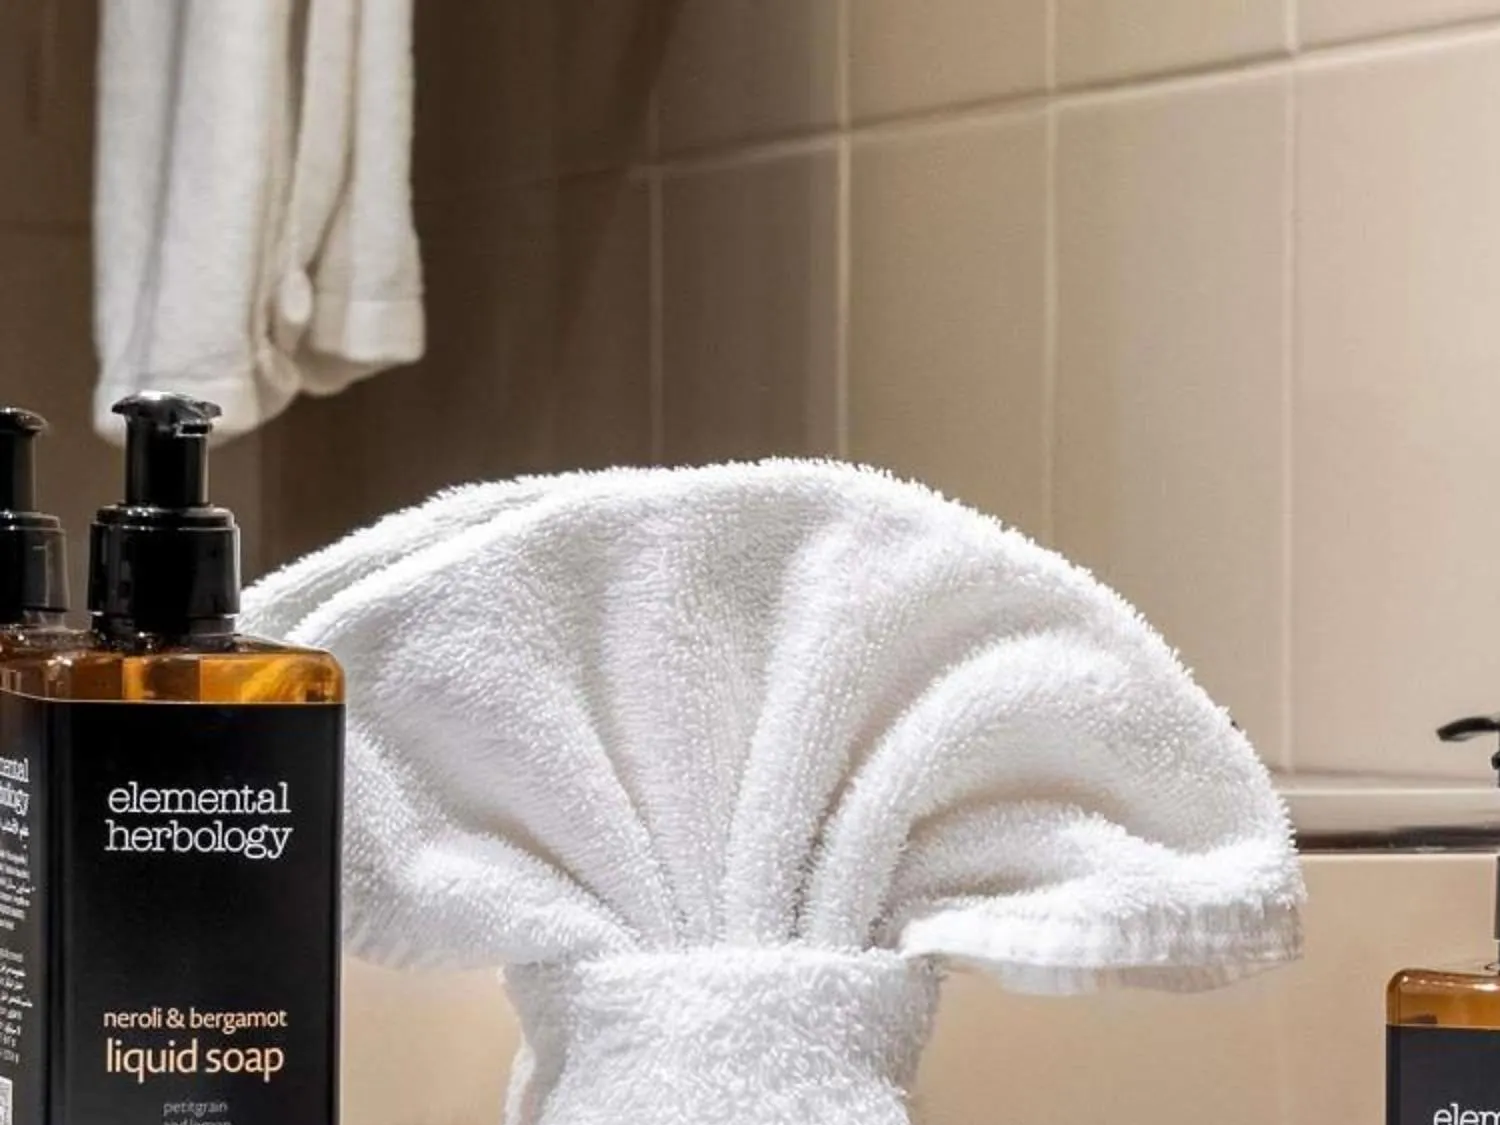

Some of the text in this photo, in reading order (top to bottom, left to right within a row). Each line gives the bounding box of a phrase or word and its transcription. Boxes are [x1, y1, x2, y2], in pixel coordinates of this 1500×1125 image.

[107, 781, 292, 813] elemental
[104, 819, 294, 859] herbology
[103, 1007, 288, 1035] neroli & bergamot
[107, 1037, 285, 1084] liquid soap
[163, 1100, 228, 1118] petitgrain
